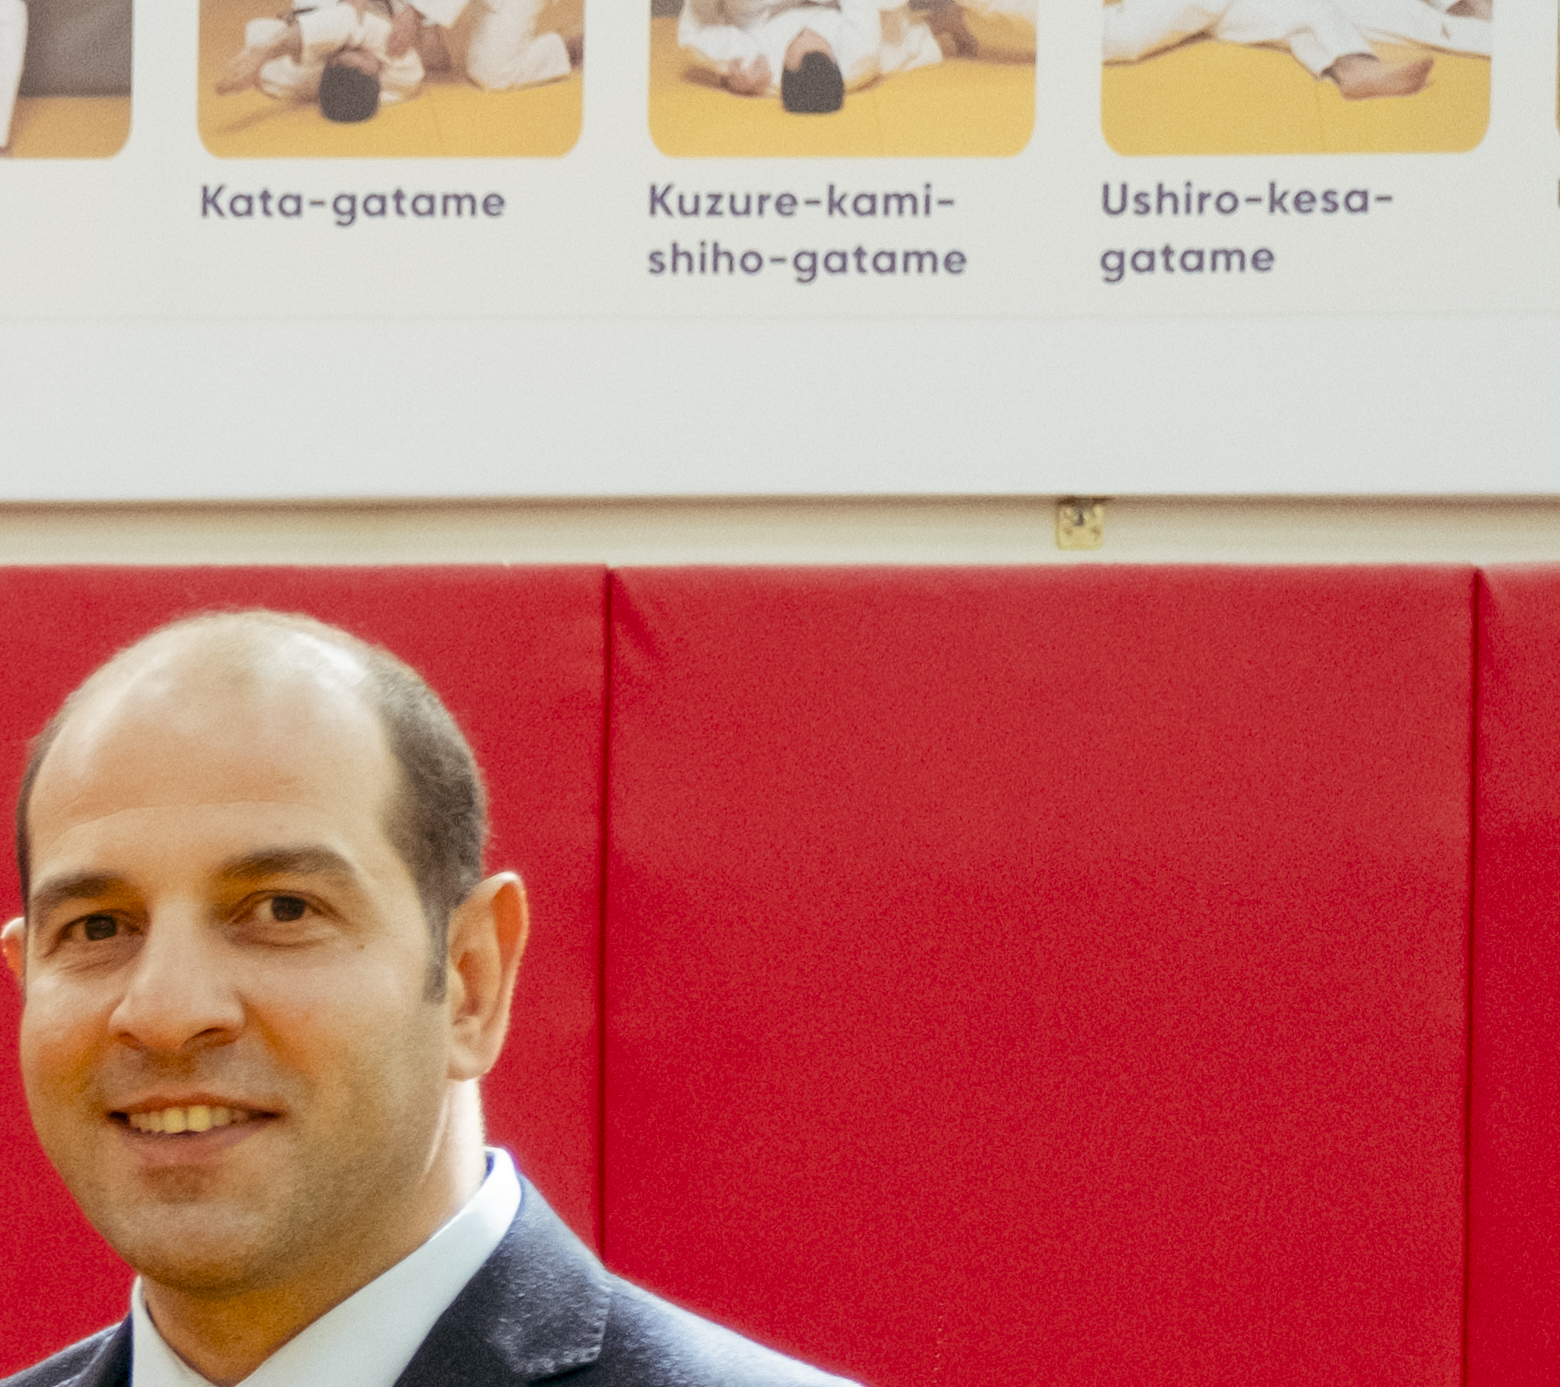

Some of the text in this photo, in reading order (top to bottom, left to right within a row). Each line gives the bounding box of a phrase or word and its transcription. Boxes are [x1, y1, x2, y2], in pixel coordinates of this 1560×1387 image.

[200, 185, 506, 227] Kata-gatame
[649, 183, 955, 217] Kuzure-kami-
[1102, 180, 1394, 216] Ushiro-kesa-
[648, 241, 968, 284] shiho-gatame
[1100, 244, 1275, 284] gatame
